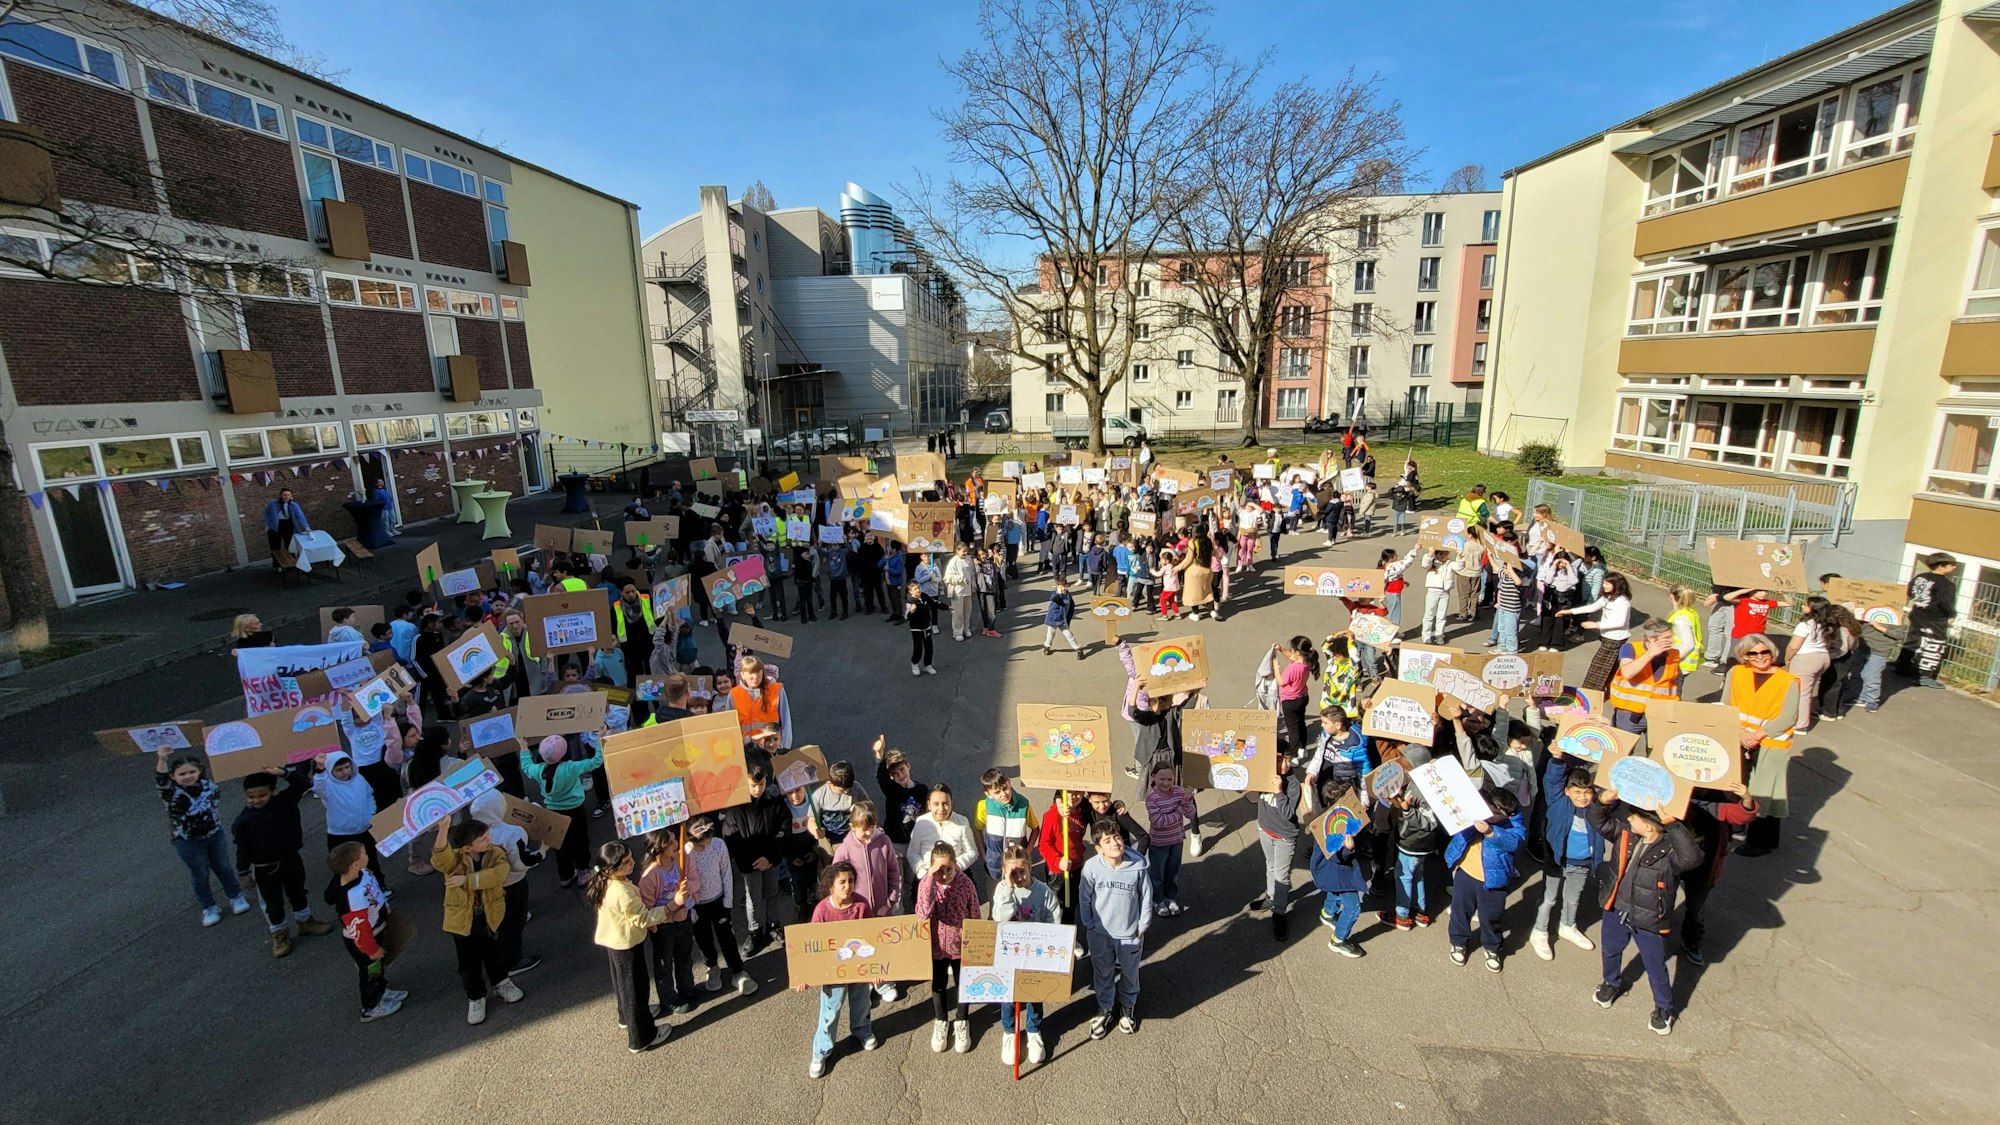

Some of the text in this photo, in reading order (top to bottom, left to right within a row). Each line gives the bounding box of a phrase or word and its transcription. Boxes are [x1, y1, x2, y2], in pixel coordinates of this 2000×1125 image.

[242, 674, 281, 694] KEIN
[548, 709, 574, 718] IKEA
[1681, 736, 1711, 746] SCHULE
[1679, 744, 1708, 754] GEGEN
[1672, 752, 1718, 764] RASSISMUS
[1106, 881, 1135, 891] ANGELES
